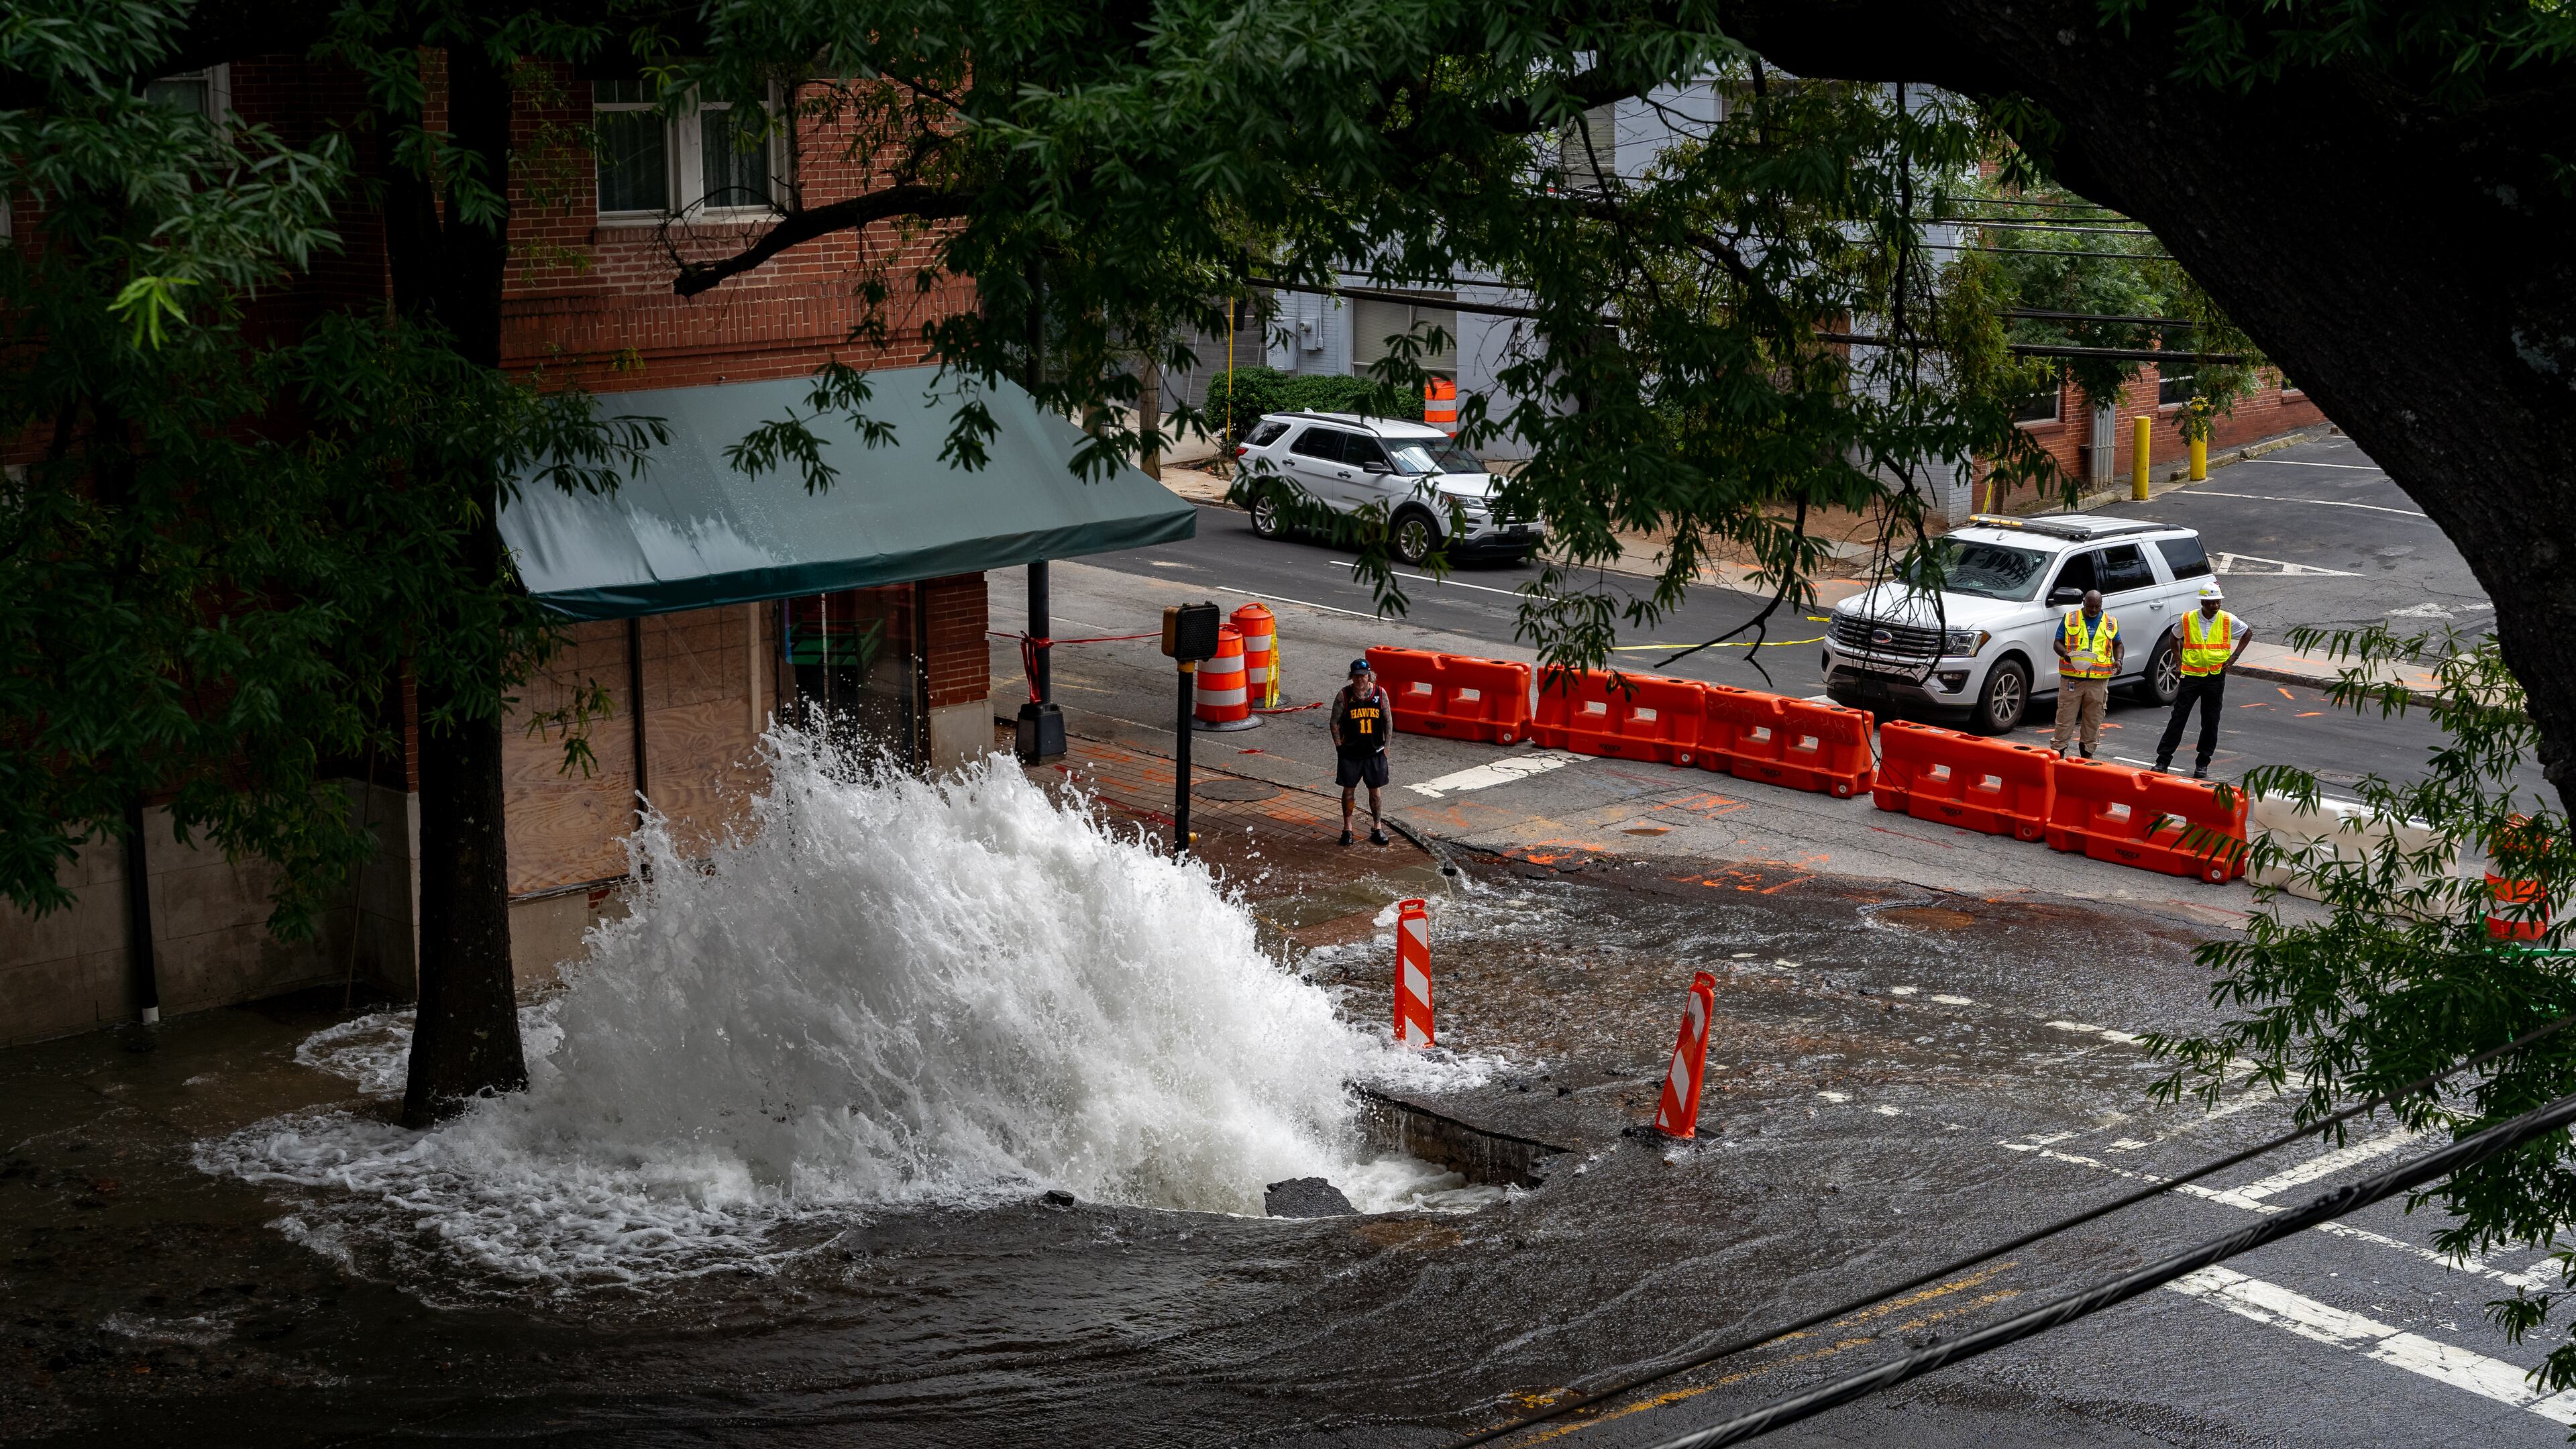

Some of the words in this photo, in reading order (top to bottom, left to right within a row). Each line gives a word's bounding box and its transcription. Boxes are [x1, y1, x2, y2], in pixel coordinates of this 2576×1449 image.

[1507, 342, 1527, 354] 1038
[1350, 708, 1380, 719] HAWKS
[1360, 718, 1373, 734] 11
